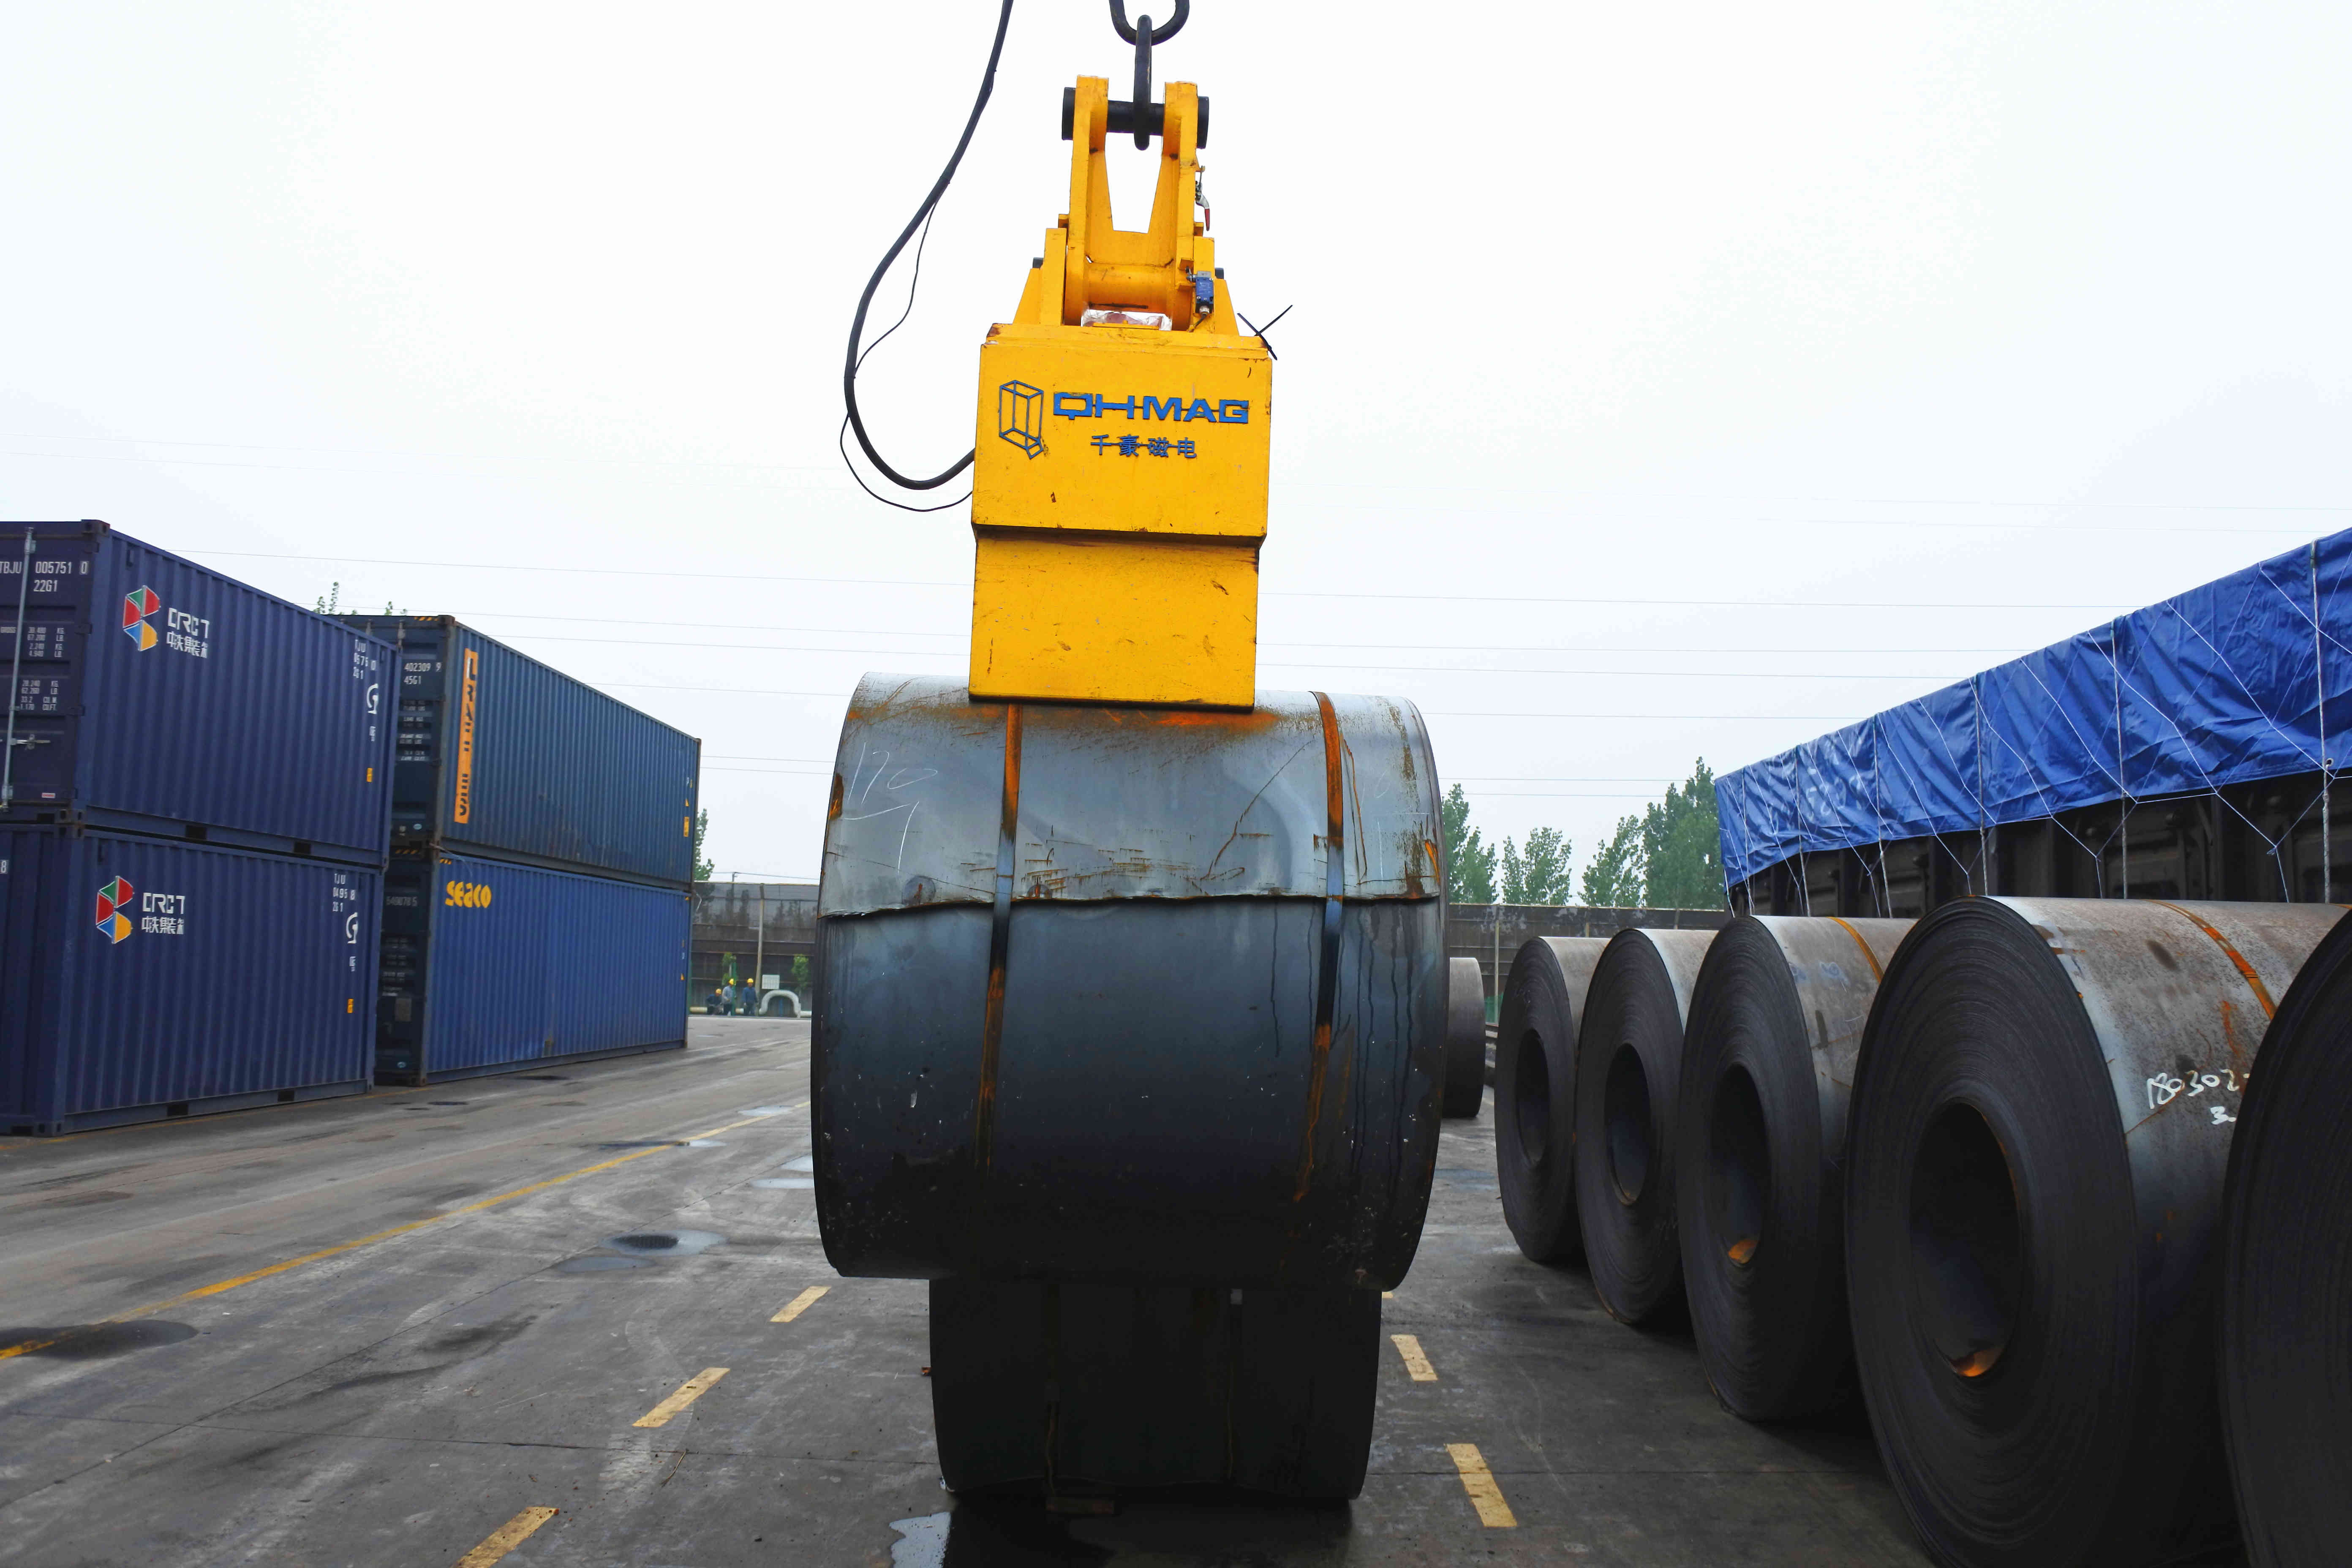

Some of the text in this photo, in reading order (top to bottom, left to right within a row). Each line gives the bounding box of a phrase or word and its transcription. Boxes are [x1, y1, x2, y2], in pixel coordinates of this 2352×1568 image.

[1053, 392, 1249, 424] QHMAG
[1091, 434, 1197, 458] 千豪磁电
[35, 561, 72, 574] 005751
[80, 561, 88, 574] 0
[33, 579, 58, 592] 22G1
[168, 607, 210, 638] CRCT
[142, 892, 185, 915] CRCT
